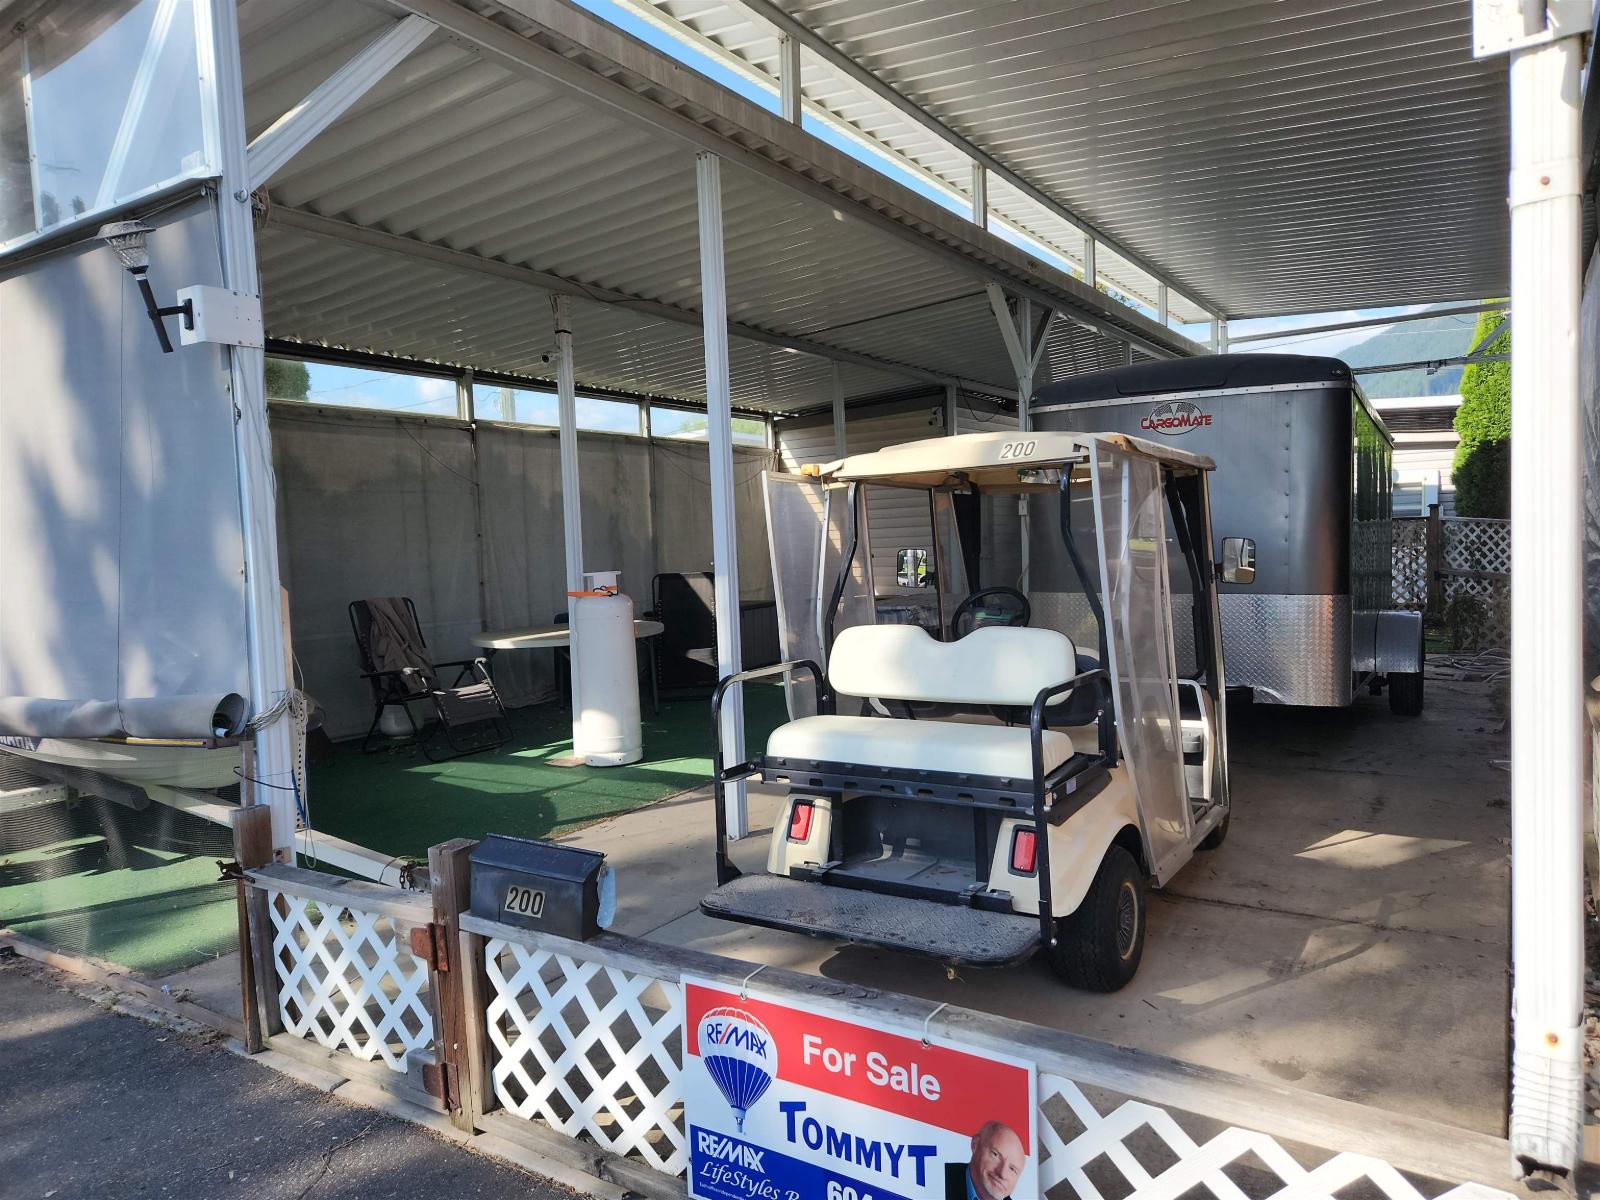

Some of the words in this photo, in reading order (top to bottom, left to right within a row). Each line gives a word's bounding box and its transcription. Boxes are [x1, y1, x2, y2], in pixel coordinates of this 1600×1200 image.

[1000, 441, 1036, 459] 200
[506, 886, 544, 916] 200
[706, 1023, 767, 1060] RE/MAX
[803, 1034, 857, 1076] For
[866, 1051, 941, 1101] Sale
[698, 1131, 766, 1174] RE/MAX
[700, 1161, 781, 1200] LifeStyles
